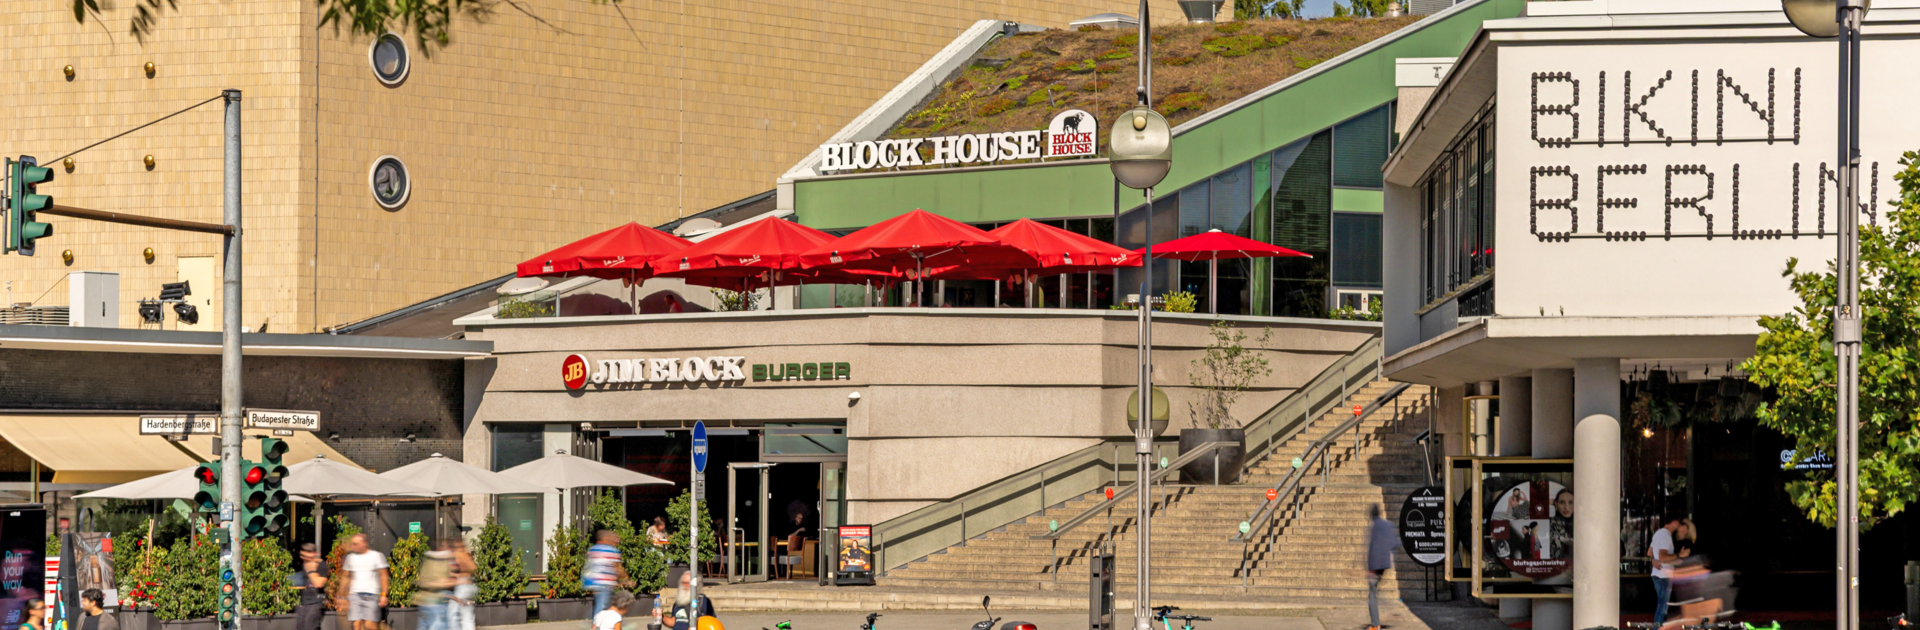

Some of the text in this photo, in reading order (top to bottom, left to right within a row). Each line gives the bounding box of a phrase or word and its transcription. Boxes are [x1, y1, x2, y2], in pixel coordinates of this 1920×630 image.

[1531, 67, 1801, 147] BIKINI
[1052, 132, 1092, 145] BLOCK
[819, 130, 1041, 171] BLOCK HOUSE
[1052, 143, 1092, 155] HOUSE
[1530, 161, 1878, 242] BERLIN
[565, 361, 584, 382] JB
[592, 356, 851, 384] JIM BLOCK BURGER
[147, 418, 211, 431] Hardenbergstraße
[252, 413, 315, 425] Budapester Straße
[5, 550, 23, 563] Run
[3, 565, 24, 580] your
[2, 579, 24, 592] way.
